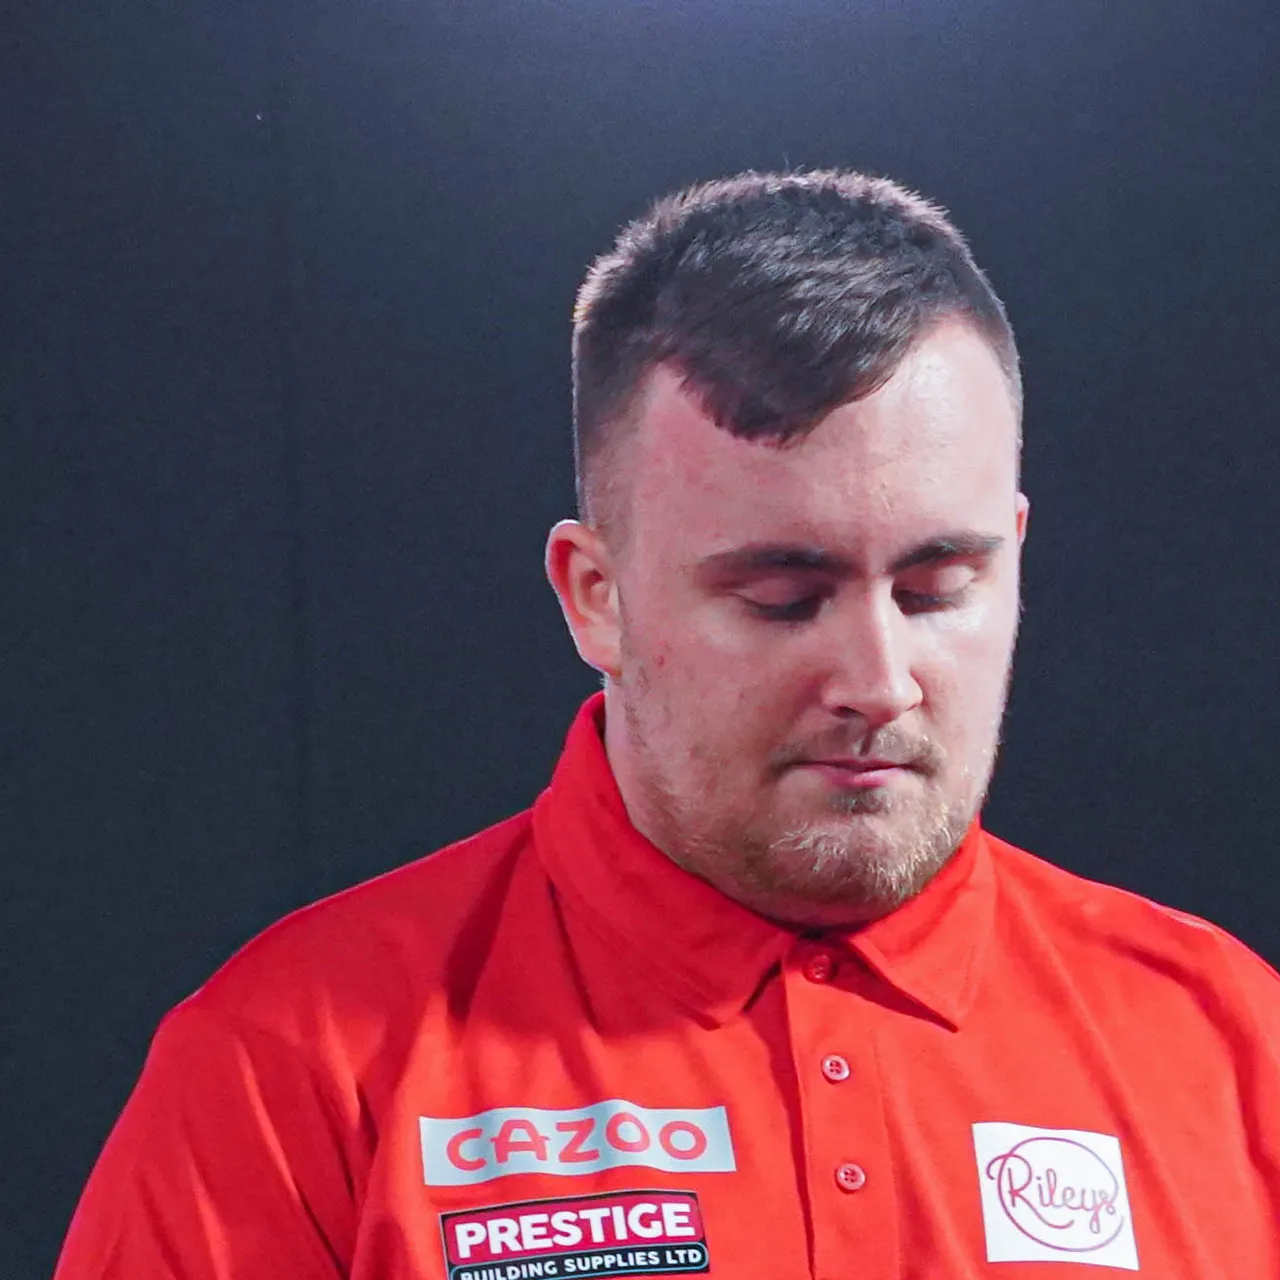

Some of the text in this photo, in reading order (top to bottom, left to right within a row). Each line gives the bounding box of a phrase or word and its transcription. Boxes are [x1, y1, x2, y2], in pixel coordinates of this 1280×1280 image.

[446, 1112, 708, 1172] CAZOO
[986, 1154, 1117, 1234] Rileys
[455, 1202, 697, 1259] PRESTIGE
[564, 1251, 659, 1273] SUPPLIES
[666, 1249, 702, 1264] LTD
